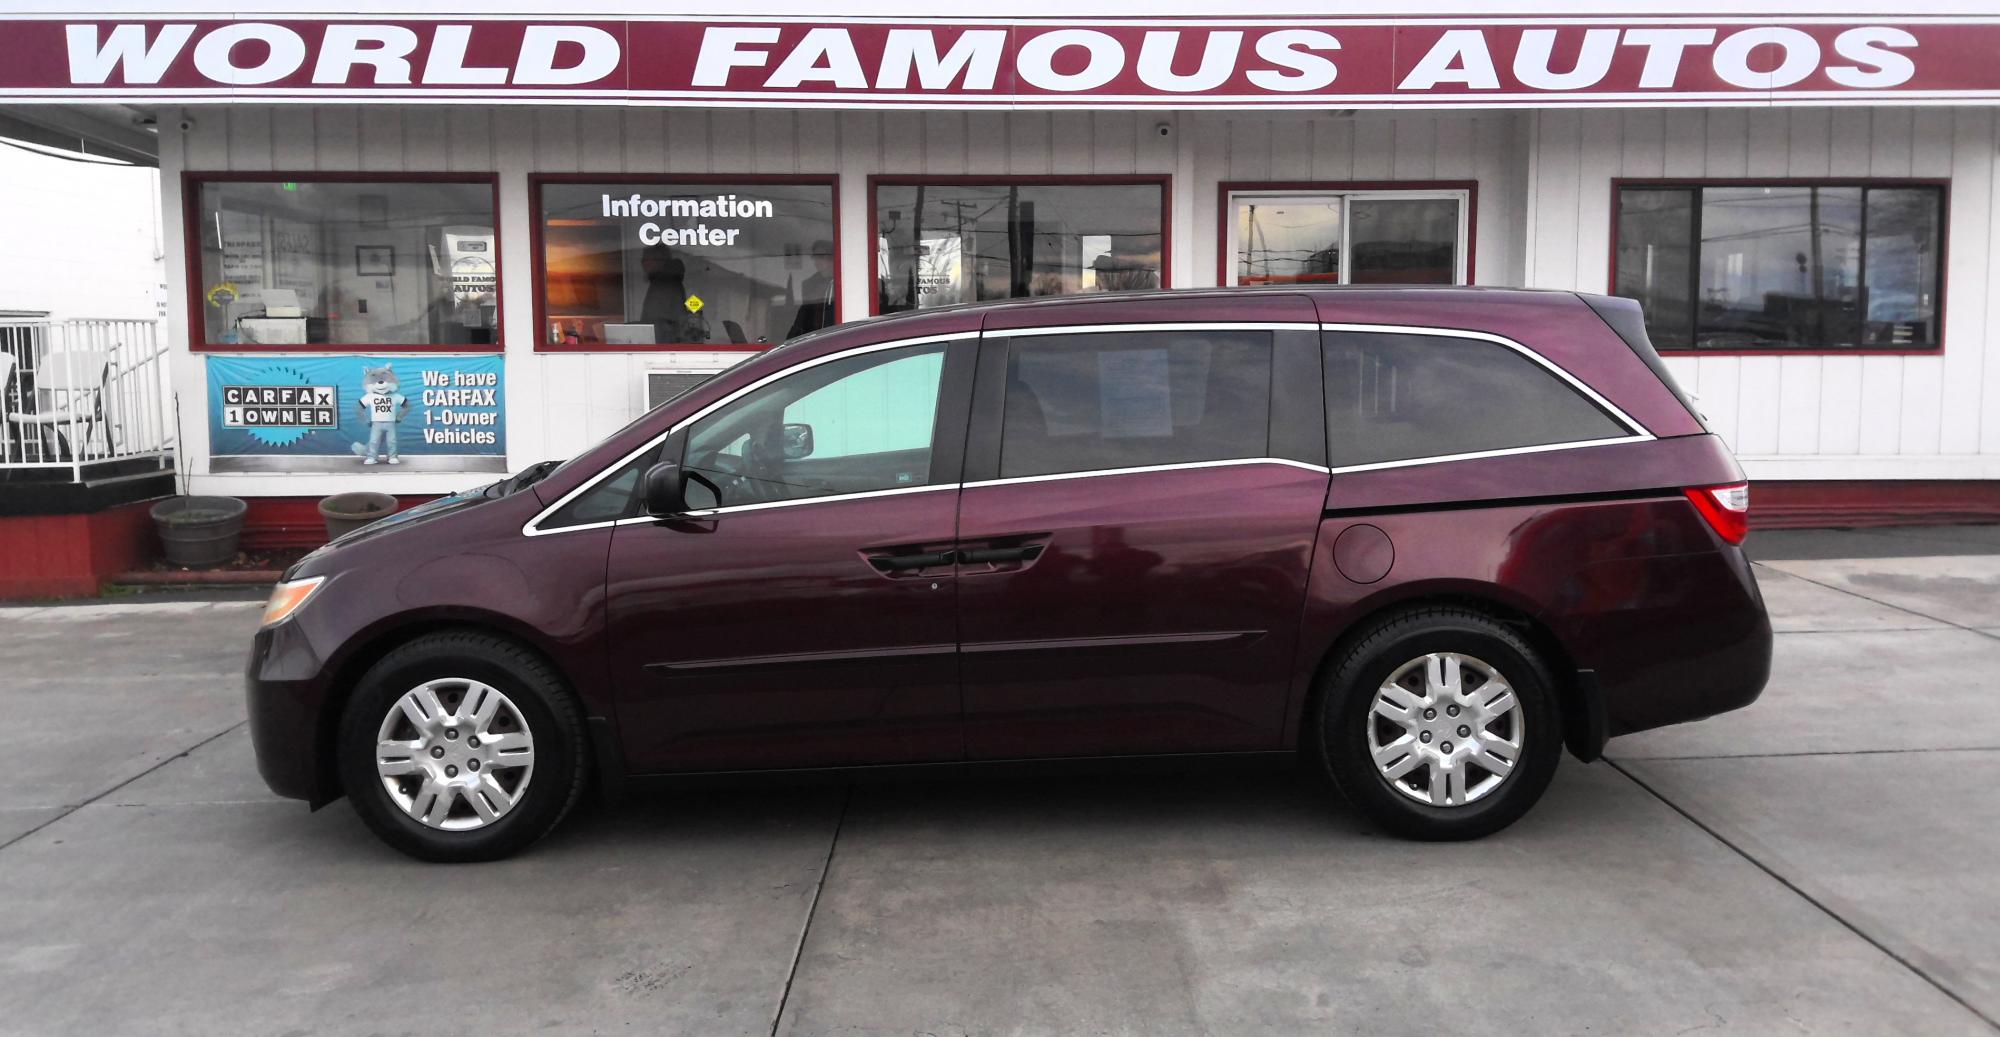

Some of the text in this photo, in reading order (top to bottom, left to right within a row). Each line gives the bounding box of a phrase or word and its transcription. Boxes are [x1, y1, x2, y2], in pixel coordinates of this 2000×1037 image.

[65, 23, 1919, 92] WORLD FAMOUS AUTOS
[602, 194, 773, 218] Information
[639, 222, 740, 246] Center
[423, 371, 497, 386] We have
[227, 390, 331, 405] CARFAX
[423, 390, 496, 406] CARFAX
[424, 409, 497, 425] 1-Owner
[424, 428, 496, 444] Vehicles
